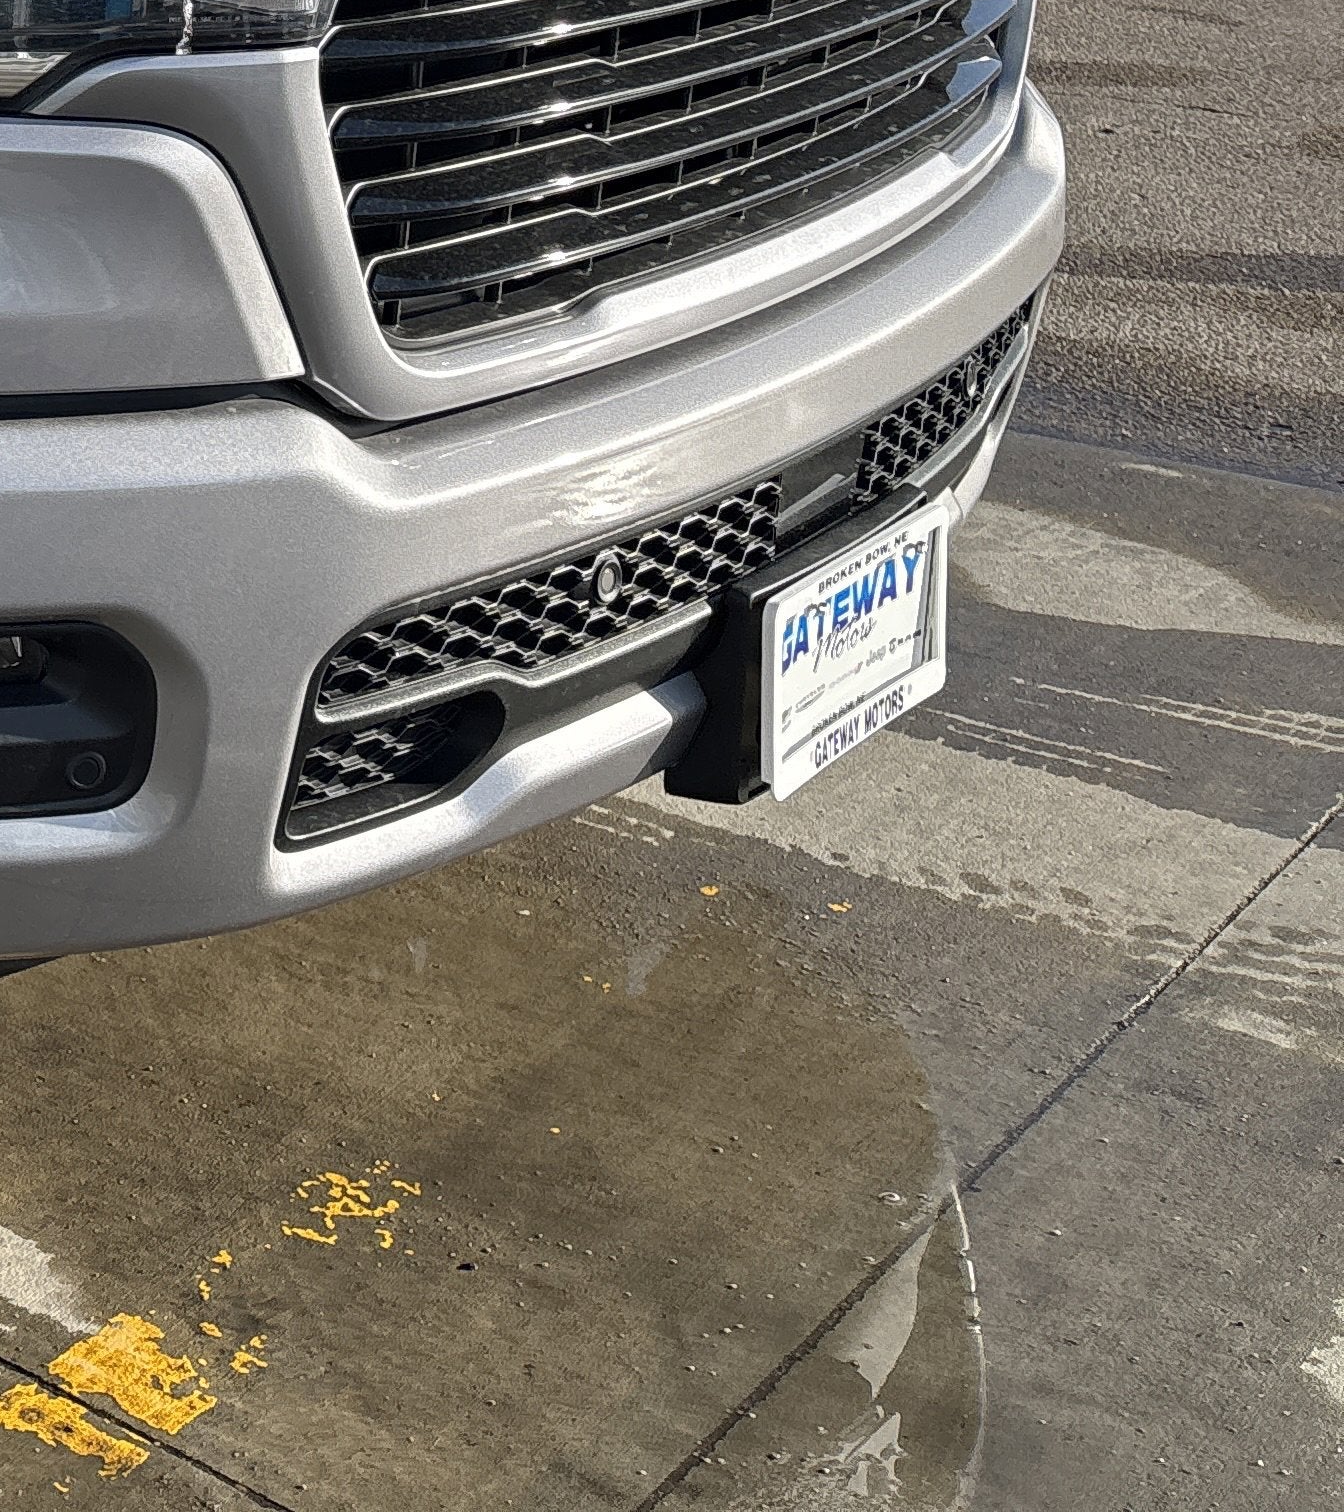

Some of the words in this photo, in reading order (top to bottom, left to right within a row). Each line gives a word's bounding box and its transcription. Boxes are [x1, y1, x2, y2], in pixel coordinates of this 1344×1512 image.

[818, 559, 862, 594] BROKEN
[893, 530, 909, 548] NE
[782, 550, 924, 677] GATEWAY
[814, 714, 861, 769] GATEWAY
[864, 685, 905, 735] MOTORS
